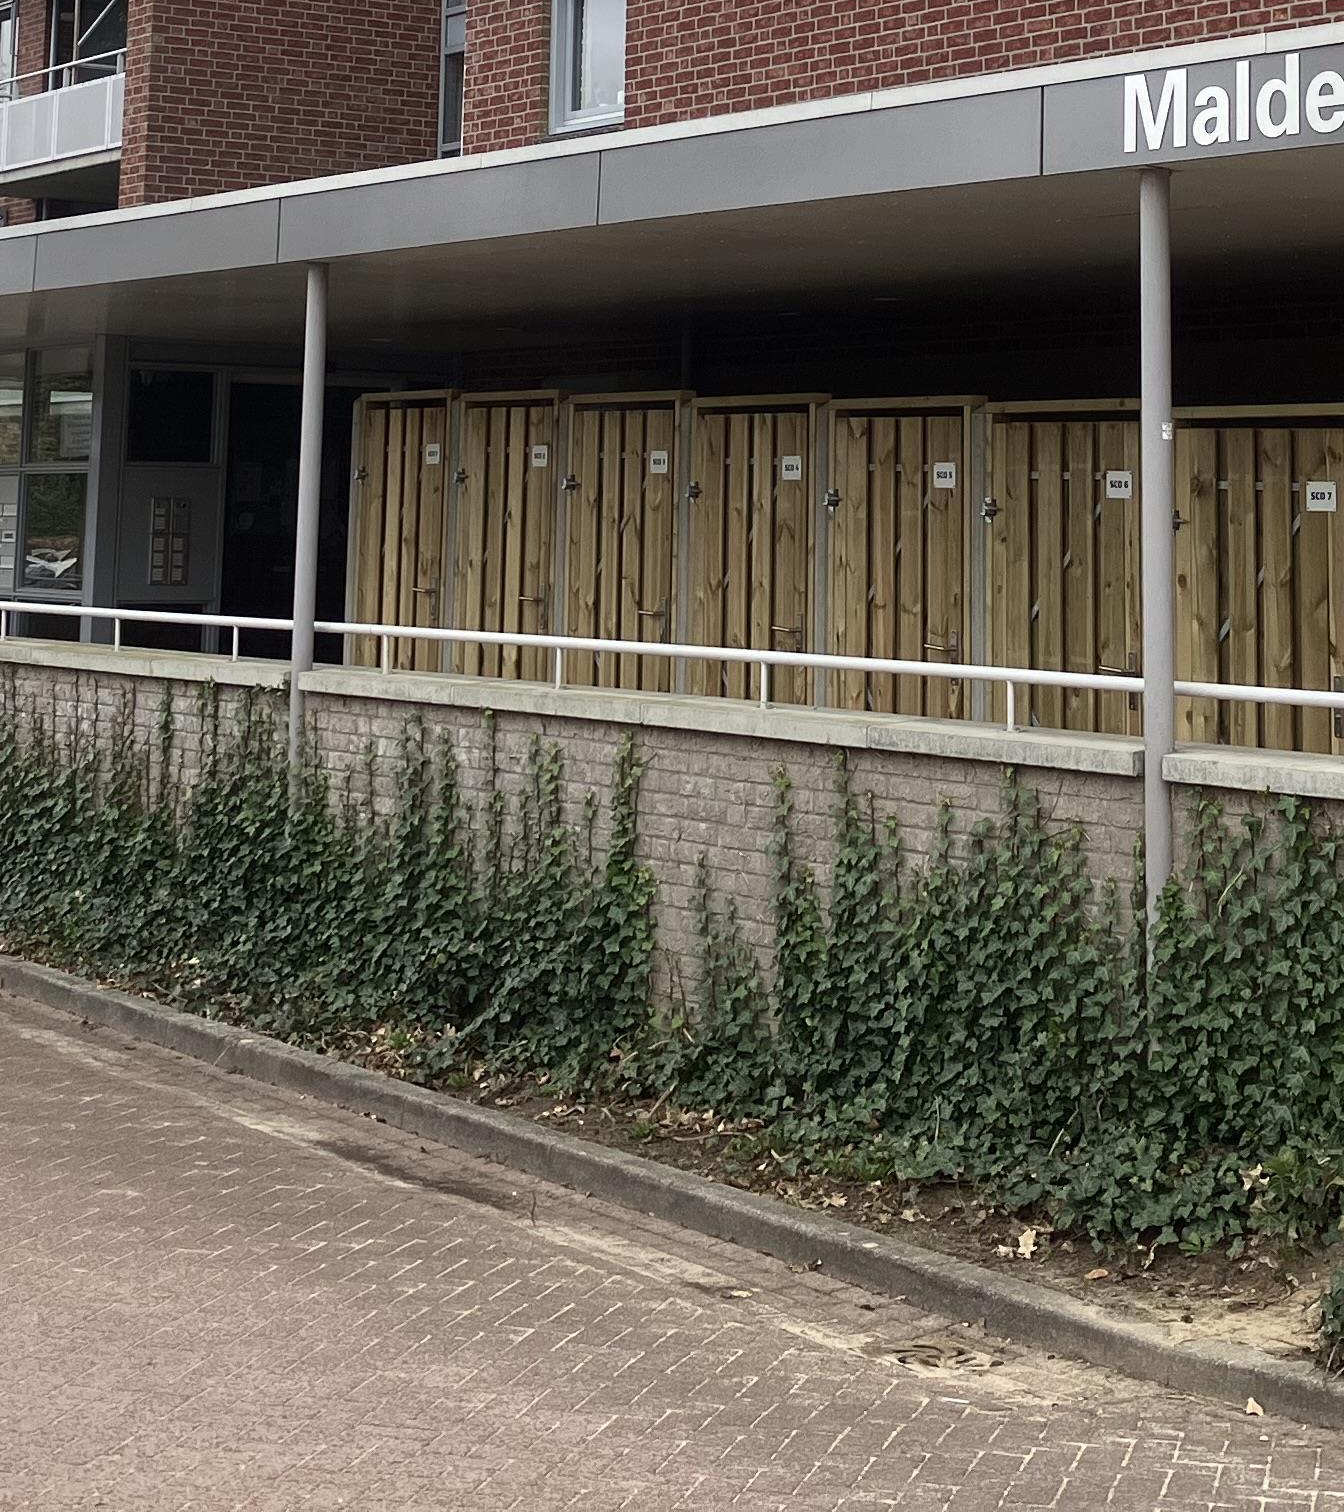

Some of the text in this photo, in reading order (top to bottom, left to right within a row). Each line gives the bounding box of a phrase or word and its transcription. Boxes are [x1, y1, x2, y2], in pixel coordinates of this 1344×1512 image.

[936, 471, 947, 479] SCO
[1109, 480, 1129, 489] SCO 6
[1310, 491, 1333, 501] SCO 7
